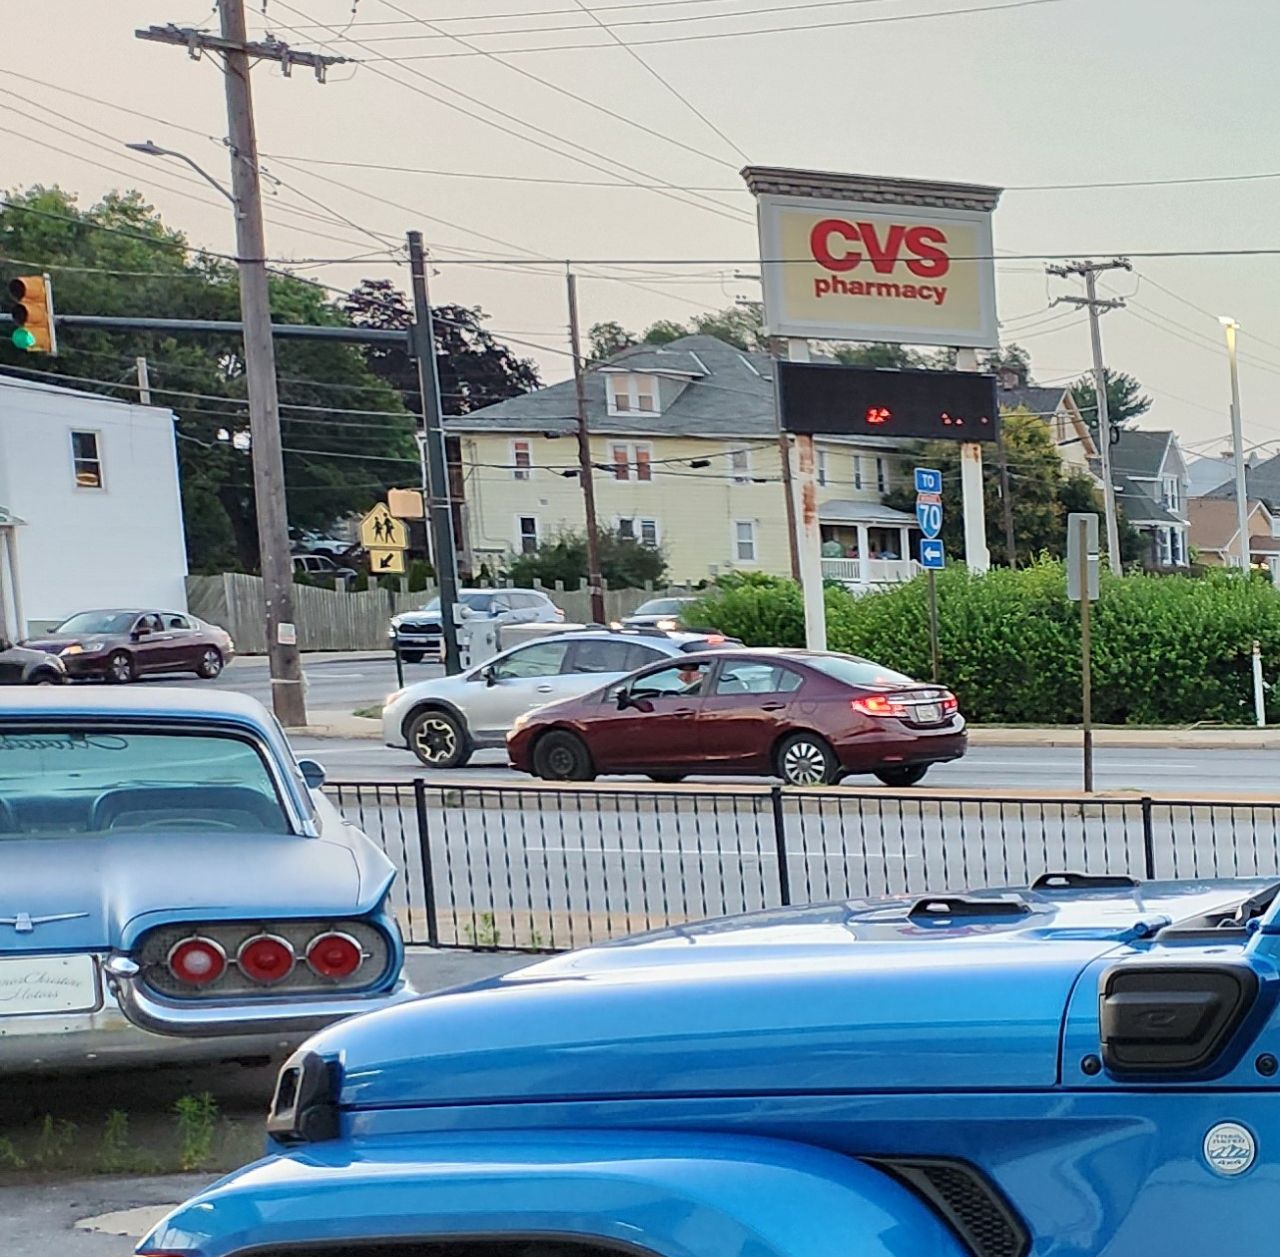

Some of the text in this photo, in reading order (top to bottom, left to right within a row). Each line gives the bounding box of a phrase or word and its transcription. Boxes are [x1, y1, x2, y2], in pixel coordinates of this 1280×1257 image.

[810, 218, 950, 278] CVS
[814, 275, 947, 305] pharmacy
[922, 474, 935, 488] TO
[919, 503, 940, 530] 70
